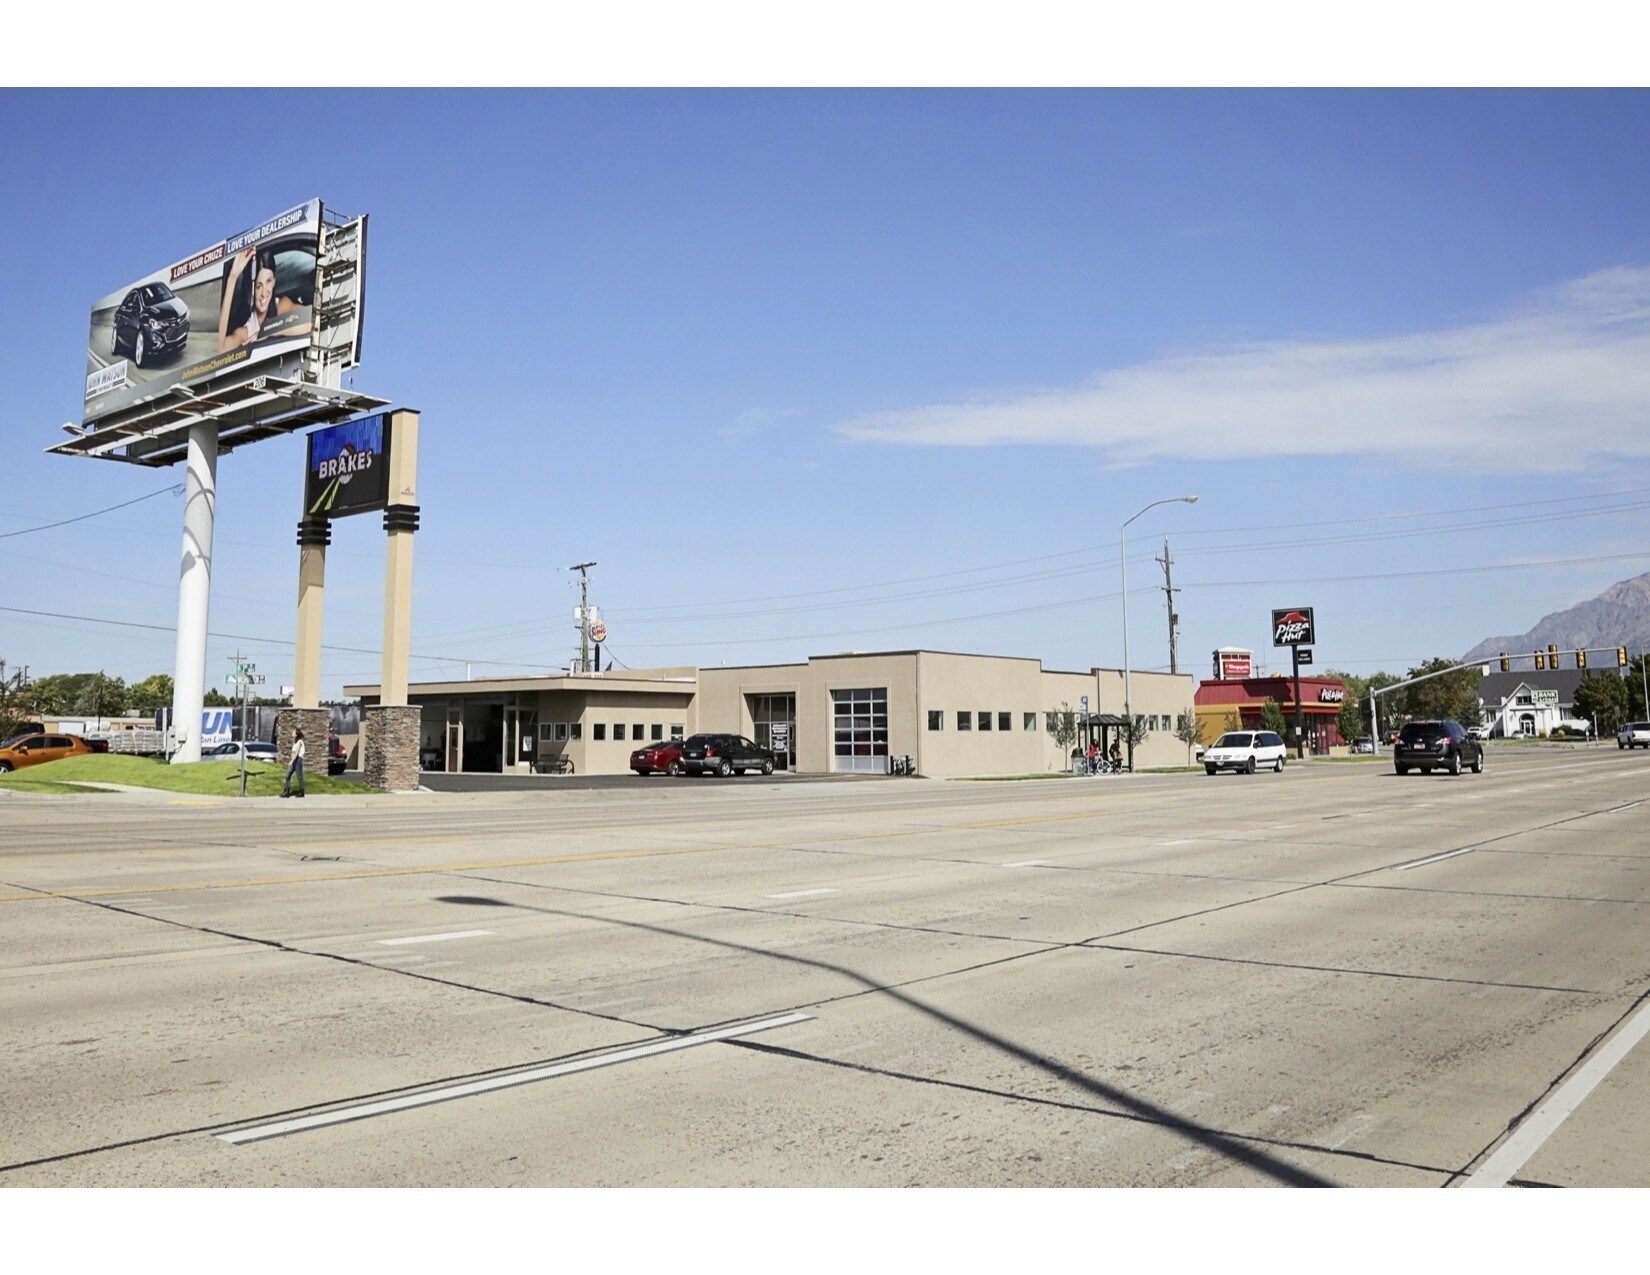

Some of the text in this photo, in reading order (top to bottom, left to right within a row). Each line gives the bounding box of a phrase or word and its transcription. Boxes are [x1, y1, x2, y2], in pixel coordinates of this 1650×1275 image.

[227, 210, 303, 253] LOVE YOUR DEALERSHIP
[173, 246, 223, 279] LOVE YOUR CRUZE
[255, 376, 266, 389] 206
[319, 451, 372, 479] BRAKES
[1275, 620, 1309, 639] Pizza
[1281, 631, 1306, 643] Hut
